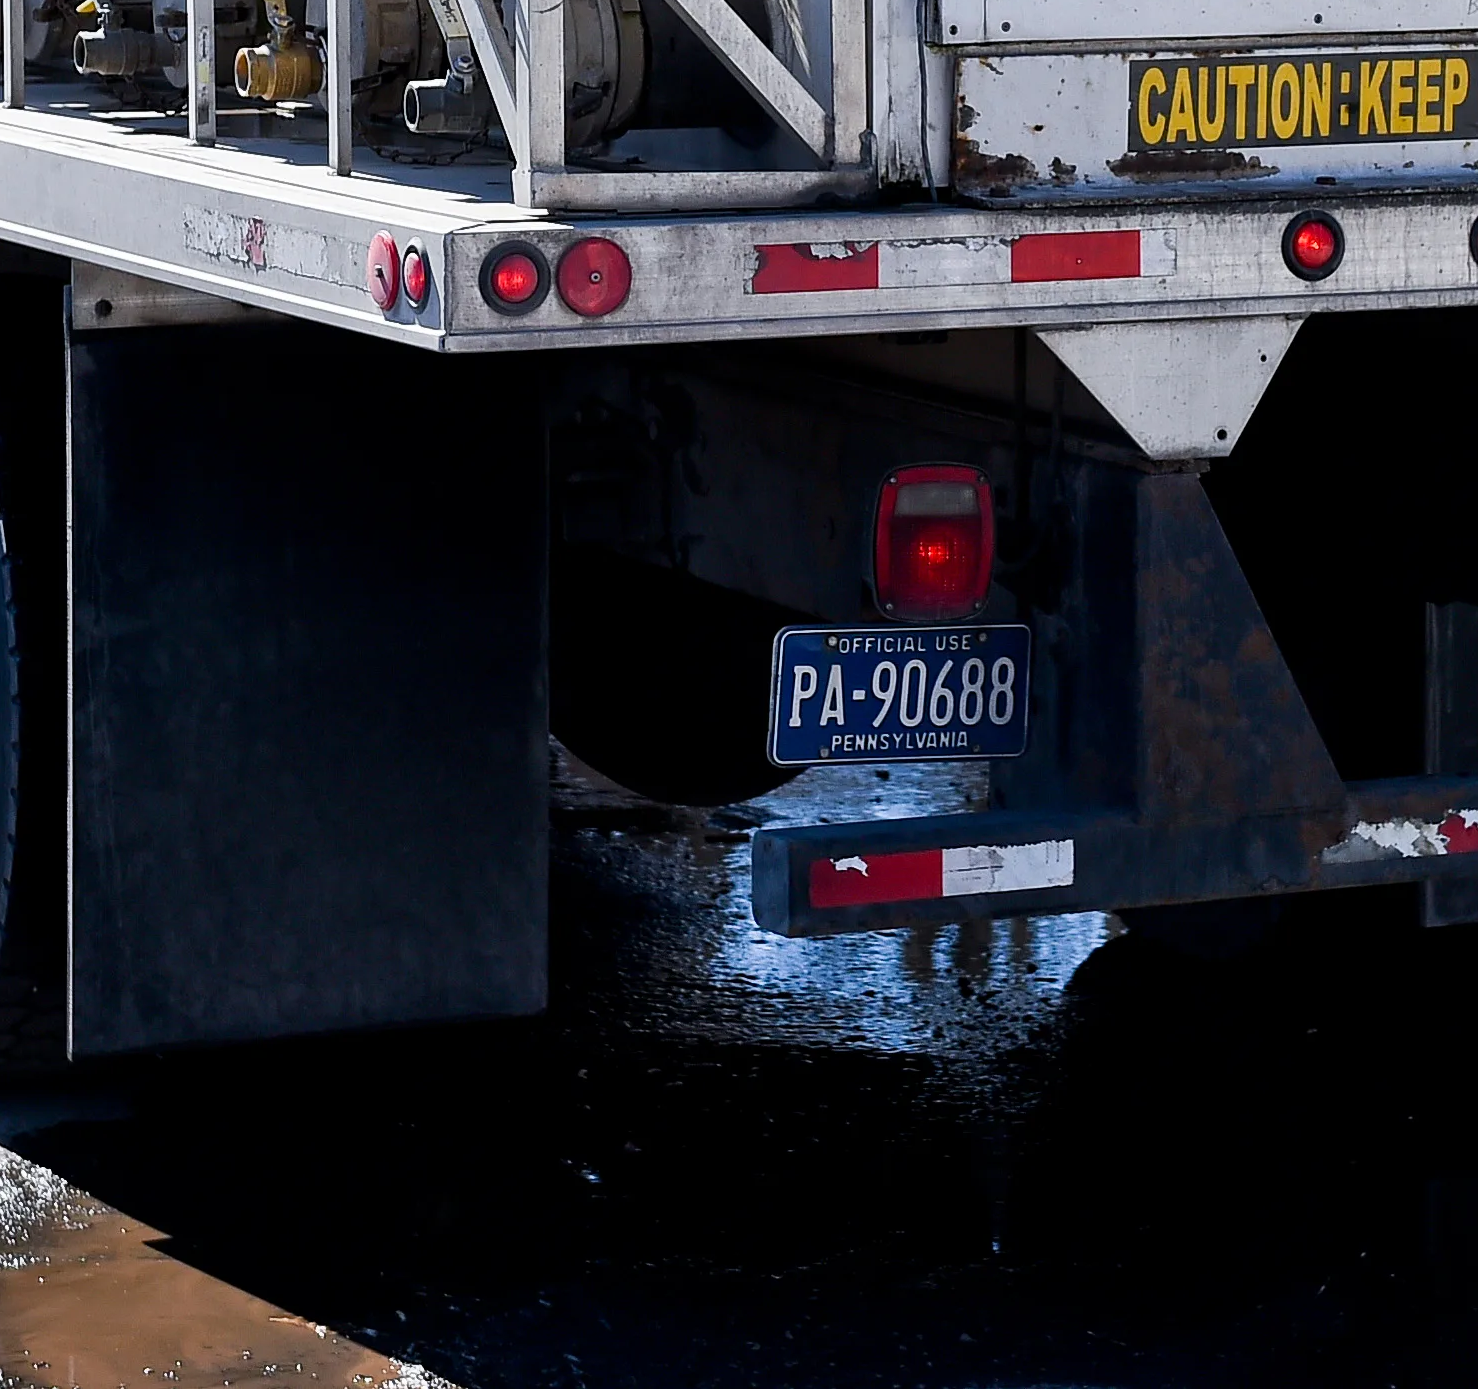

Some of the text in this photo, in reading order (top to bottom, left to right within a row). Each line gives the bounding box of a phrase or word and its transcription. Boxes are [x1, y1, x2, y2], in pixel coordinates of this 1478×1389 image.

[1358, 58, 1469, 135] KEEP
[838, 634, 972, 654] OFFICIAL USE
[788, 656, 1015, 728] PA-90688
[831, 730, 969, 752] PENNSYLVANIA
